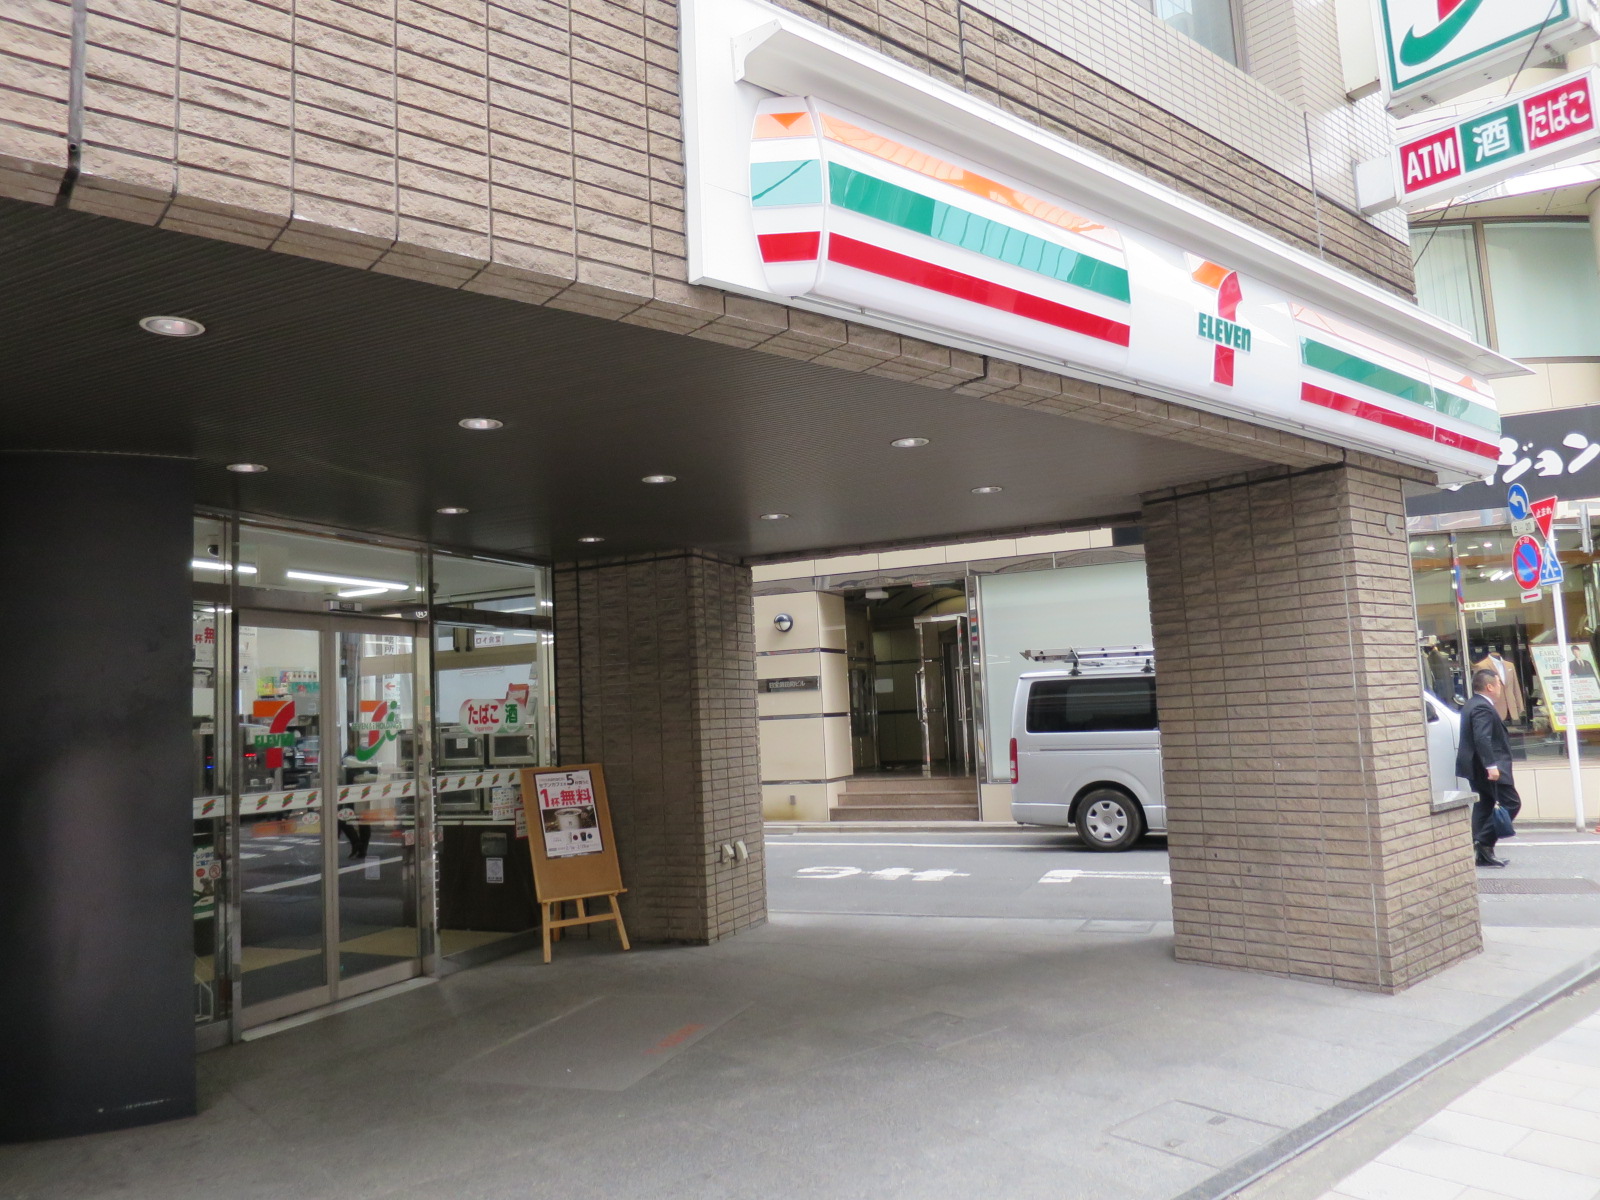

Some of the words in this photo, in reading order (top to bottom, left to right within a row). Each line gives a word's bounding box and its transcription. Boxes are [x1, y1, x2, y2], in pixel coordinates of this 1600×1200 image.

[1528, 90, 1590, 141] たばこ
[1472, 116, 1511, 163] 酒
[1407, 138, 1456, 185] ATM
[1535, 505, 1553, 520] 止まれ
[467, 703, 500, 725] たばこ
[505, 703, 518, 724] 酒
[540, 788, 592, 808] 1杯無料
